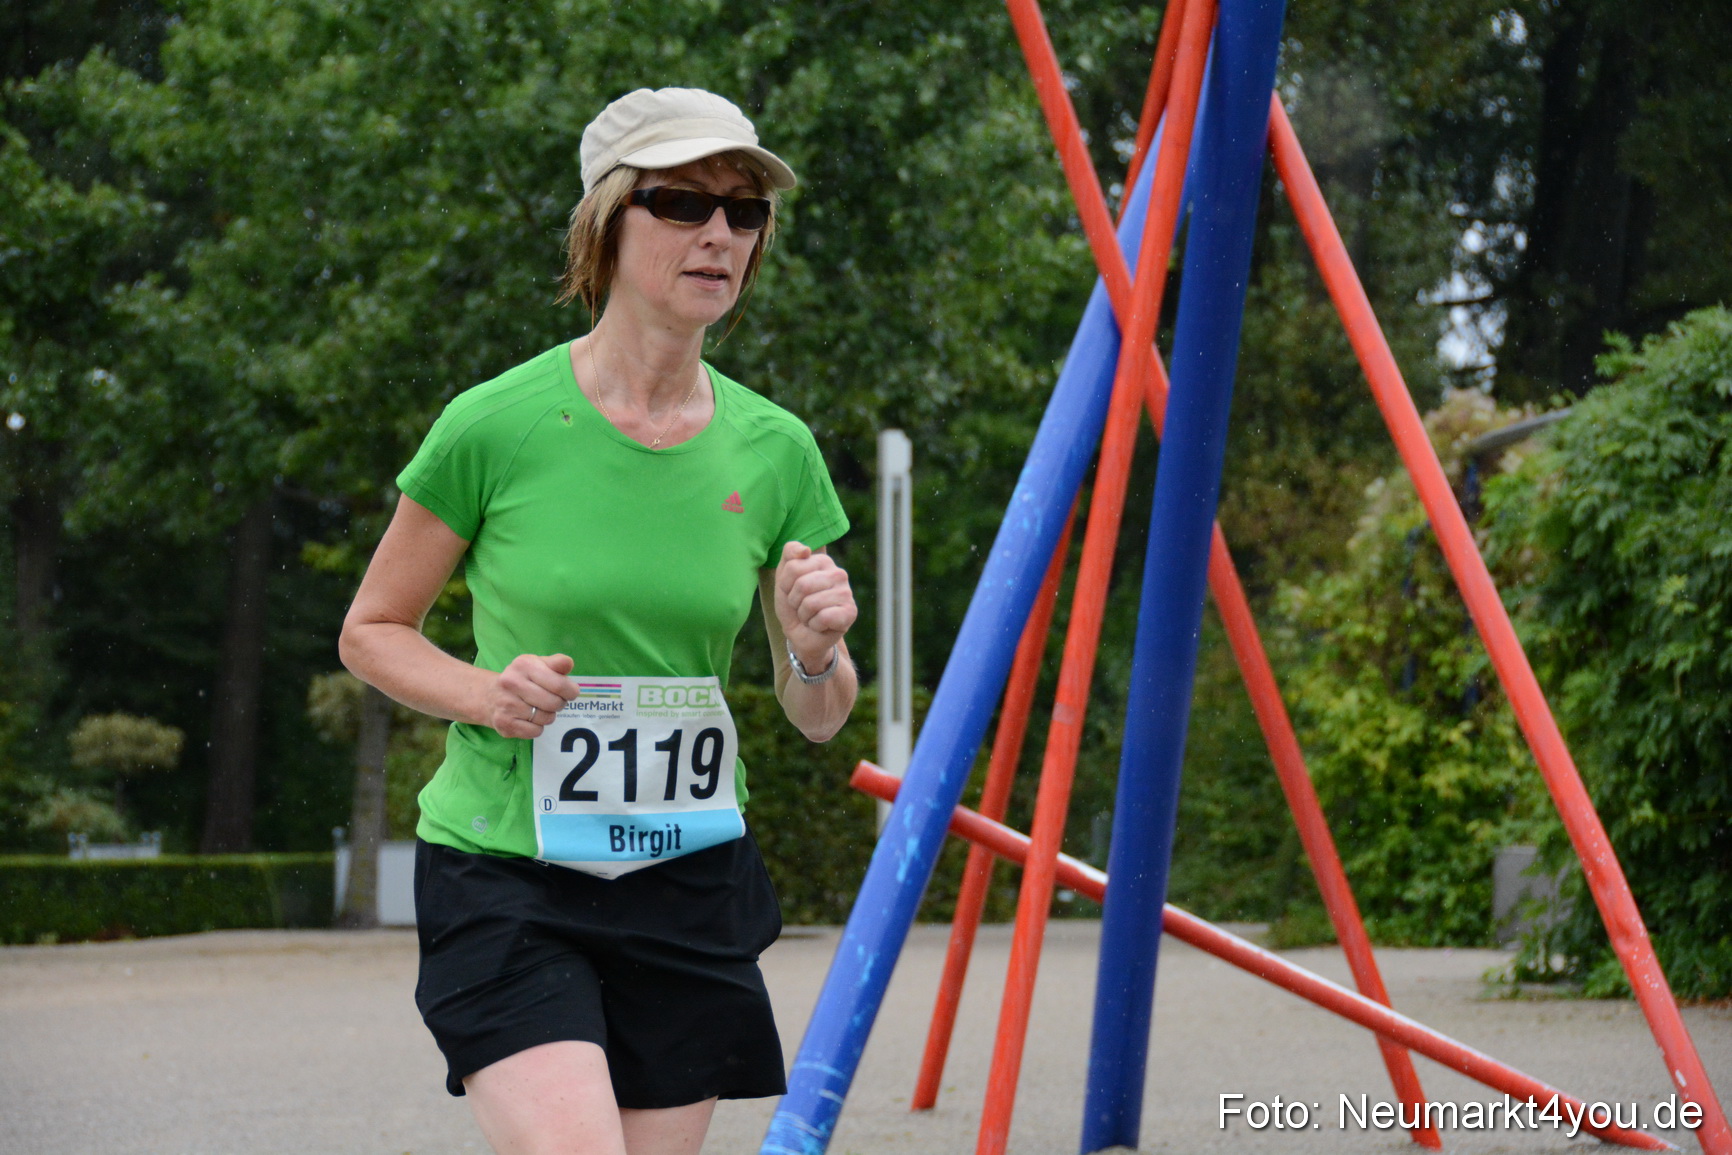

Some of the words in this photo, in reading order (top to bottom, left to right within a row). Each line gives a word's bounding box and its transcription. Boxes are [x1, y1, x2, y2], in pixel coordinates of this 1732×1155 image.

[562, 700, 624, 711] euerMarkt
[636, 710, 668, 718] inspired
[670, 710, 679, 718] by
[558, 727, 725, 802] 2119
[544, 798, 552, 811] D
[609, 824, 682, 858] Birgit
